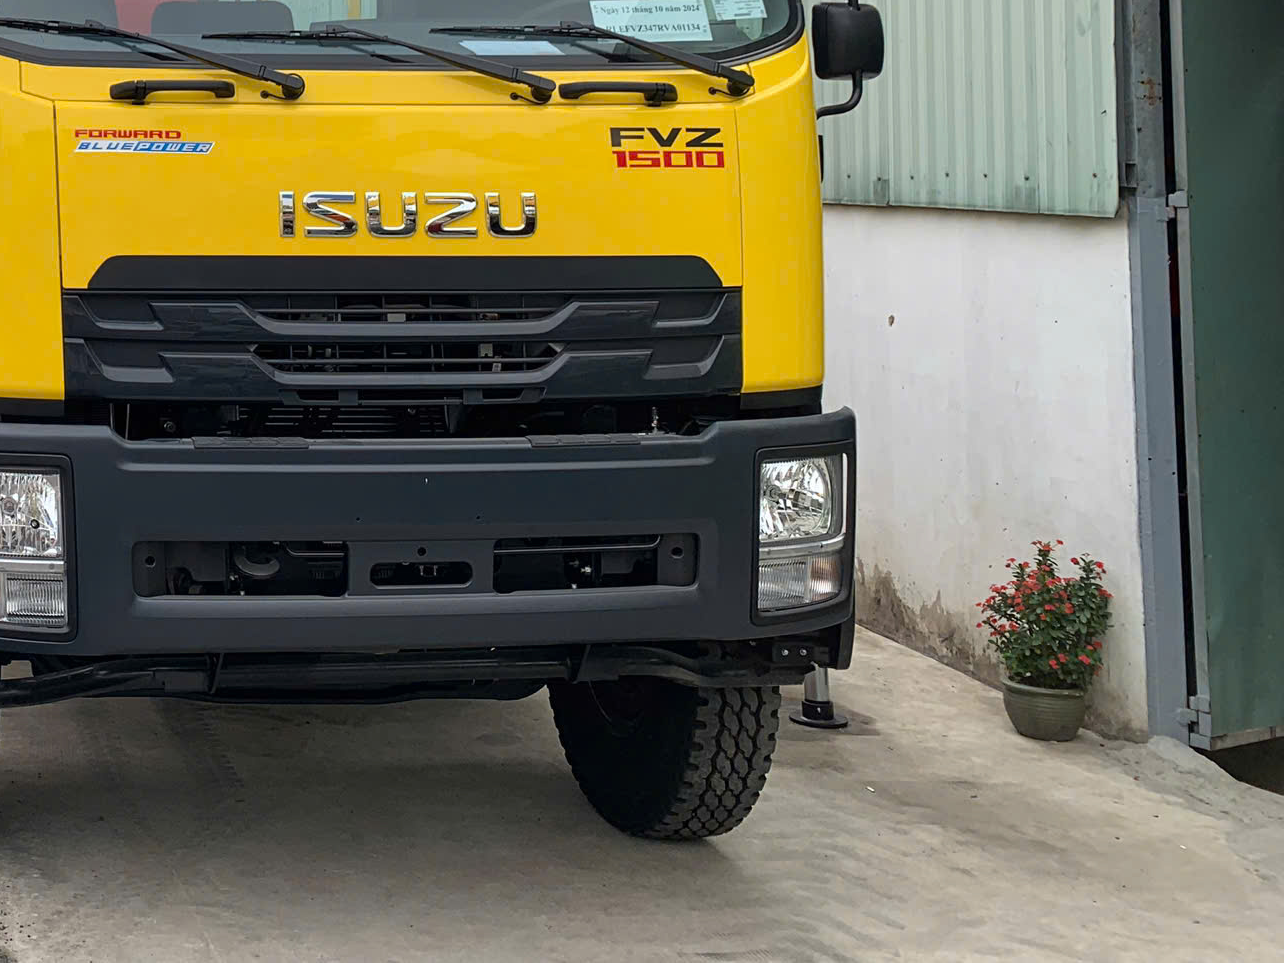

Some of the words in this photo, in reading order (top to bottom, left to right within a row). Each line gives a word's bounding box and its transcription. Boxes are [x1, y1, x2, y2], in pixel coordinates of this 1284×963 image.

[683, 4, 701, 13] 2024
[75, 128, 182, 140] FORWARD
[609, 127, 724, 148] FVZ
[77, 141, 212, 153] BLUEPOWER
[612, 150, 725, 168] 1500
[278, 190, 539, 239] ISUZU
